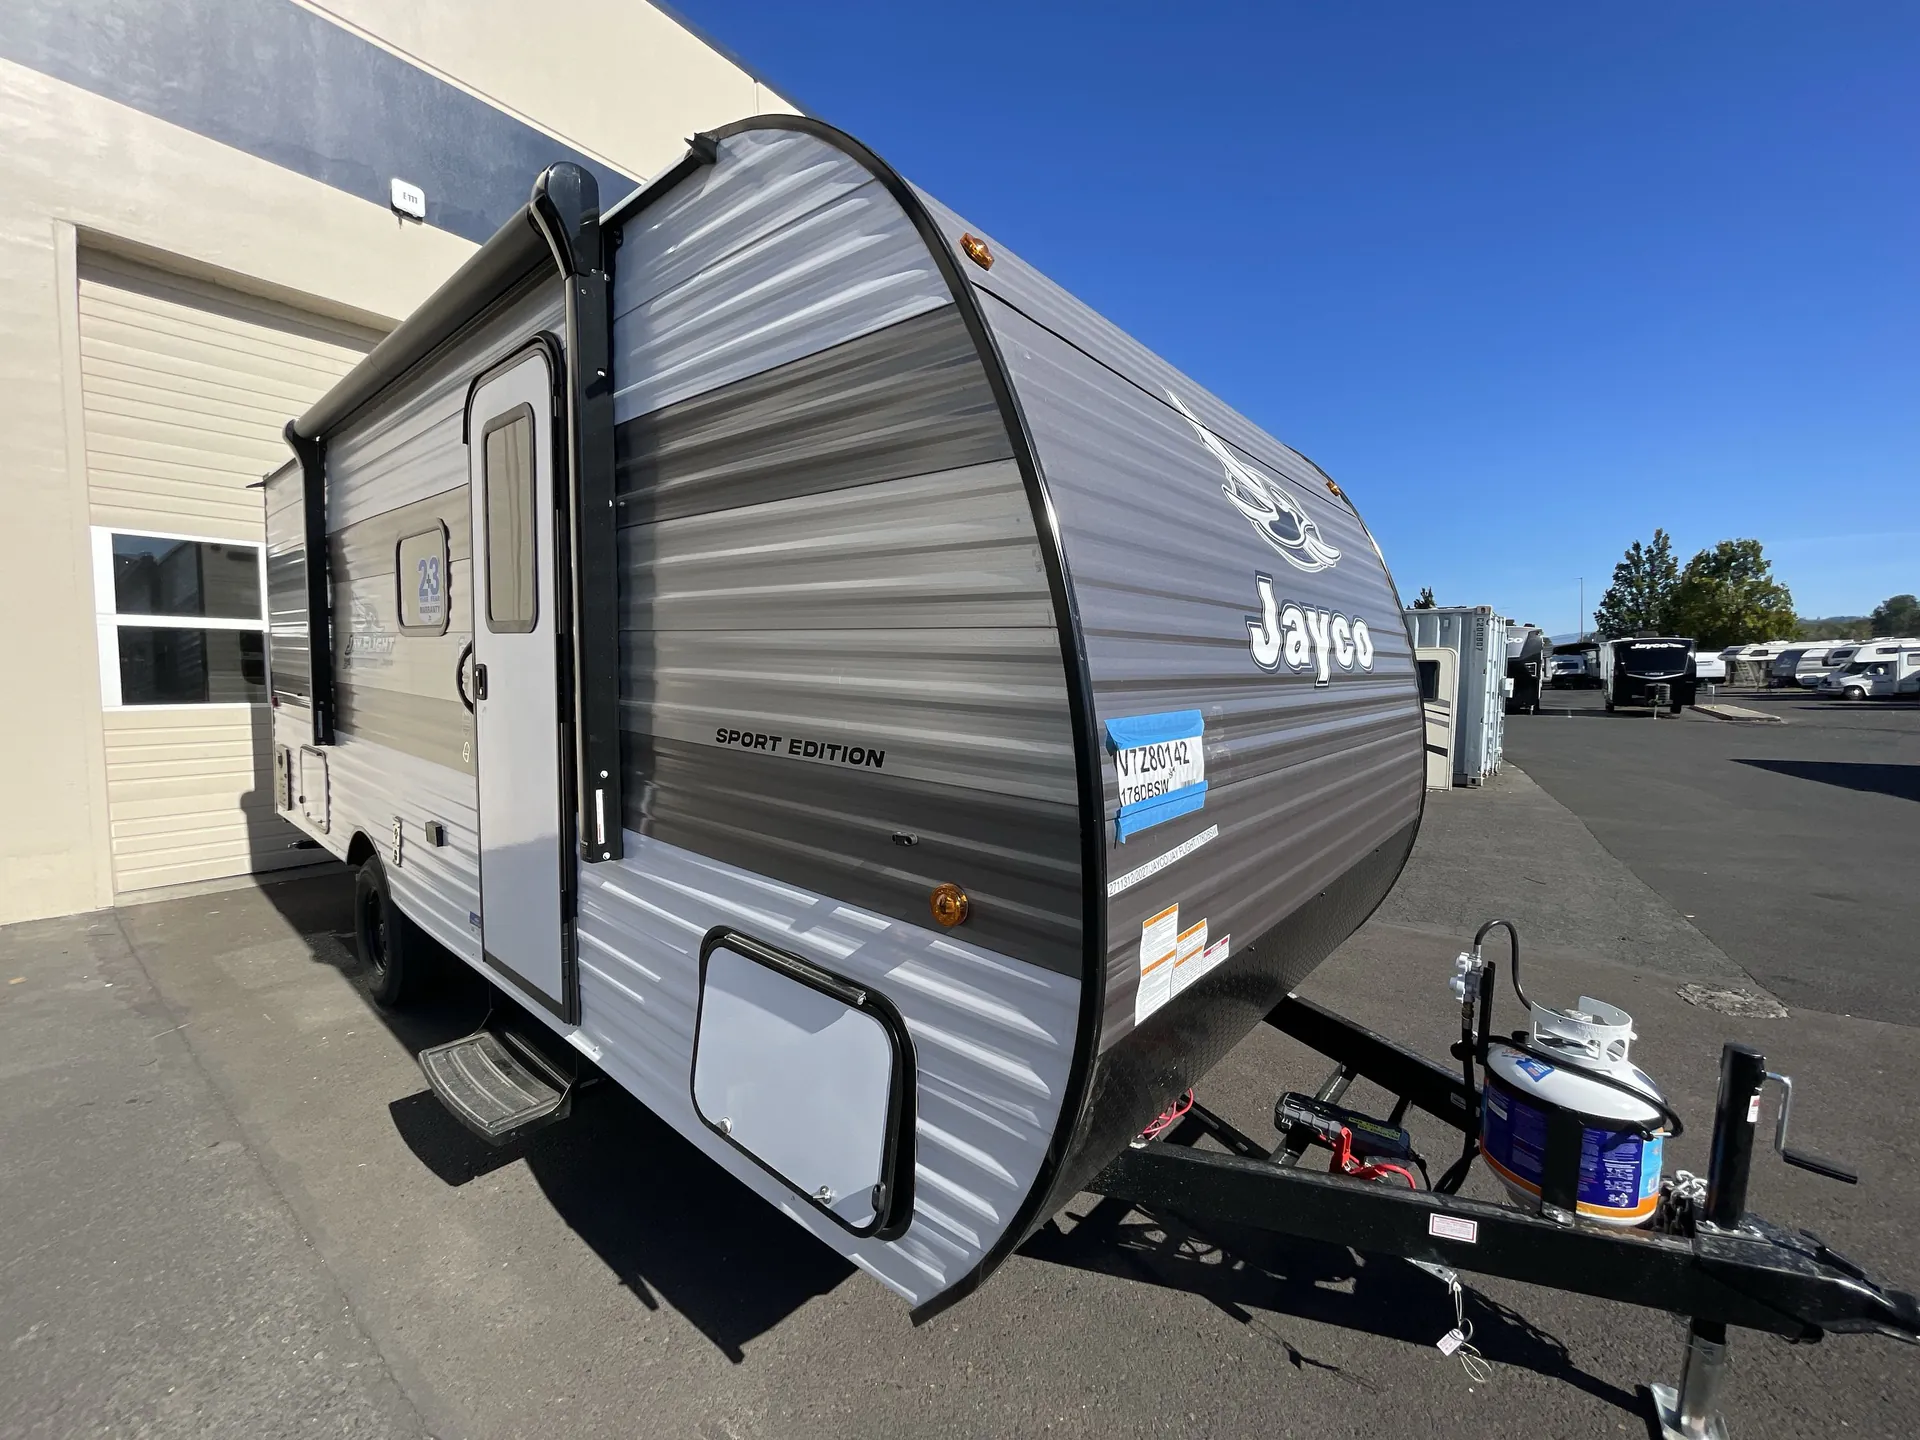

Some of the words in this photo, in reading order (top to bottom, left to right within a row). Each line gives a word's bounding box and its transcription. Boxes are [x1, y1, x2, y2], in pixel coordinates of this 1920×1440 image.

[1245, 570, 1374, 689] Jayco
[716, 728, 782, 751] SPORT
[788, 739, 885, 768] EDITION
[1118, 741, 1190, 776] V7Z80142
[1121, 778, 1170, 807] 178DBSW
